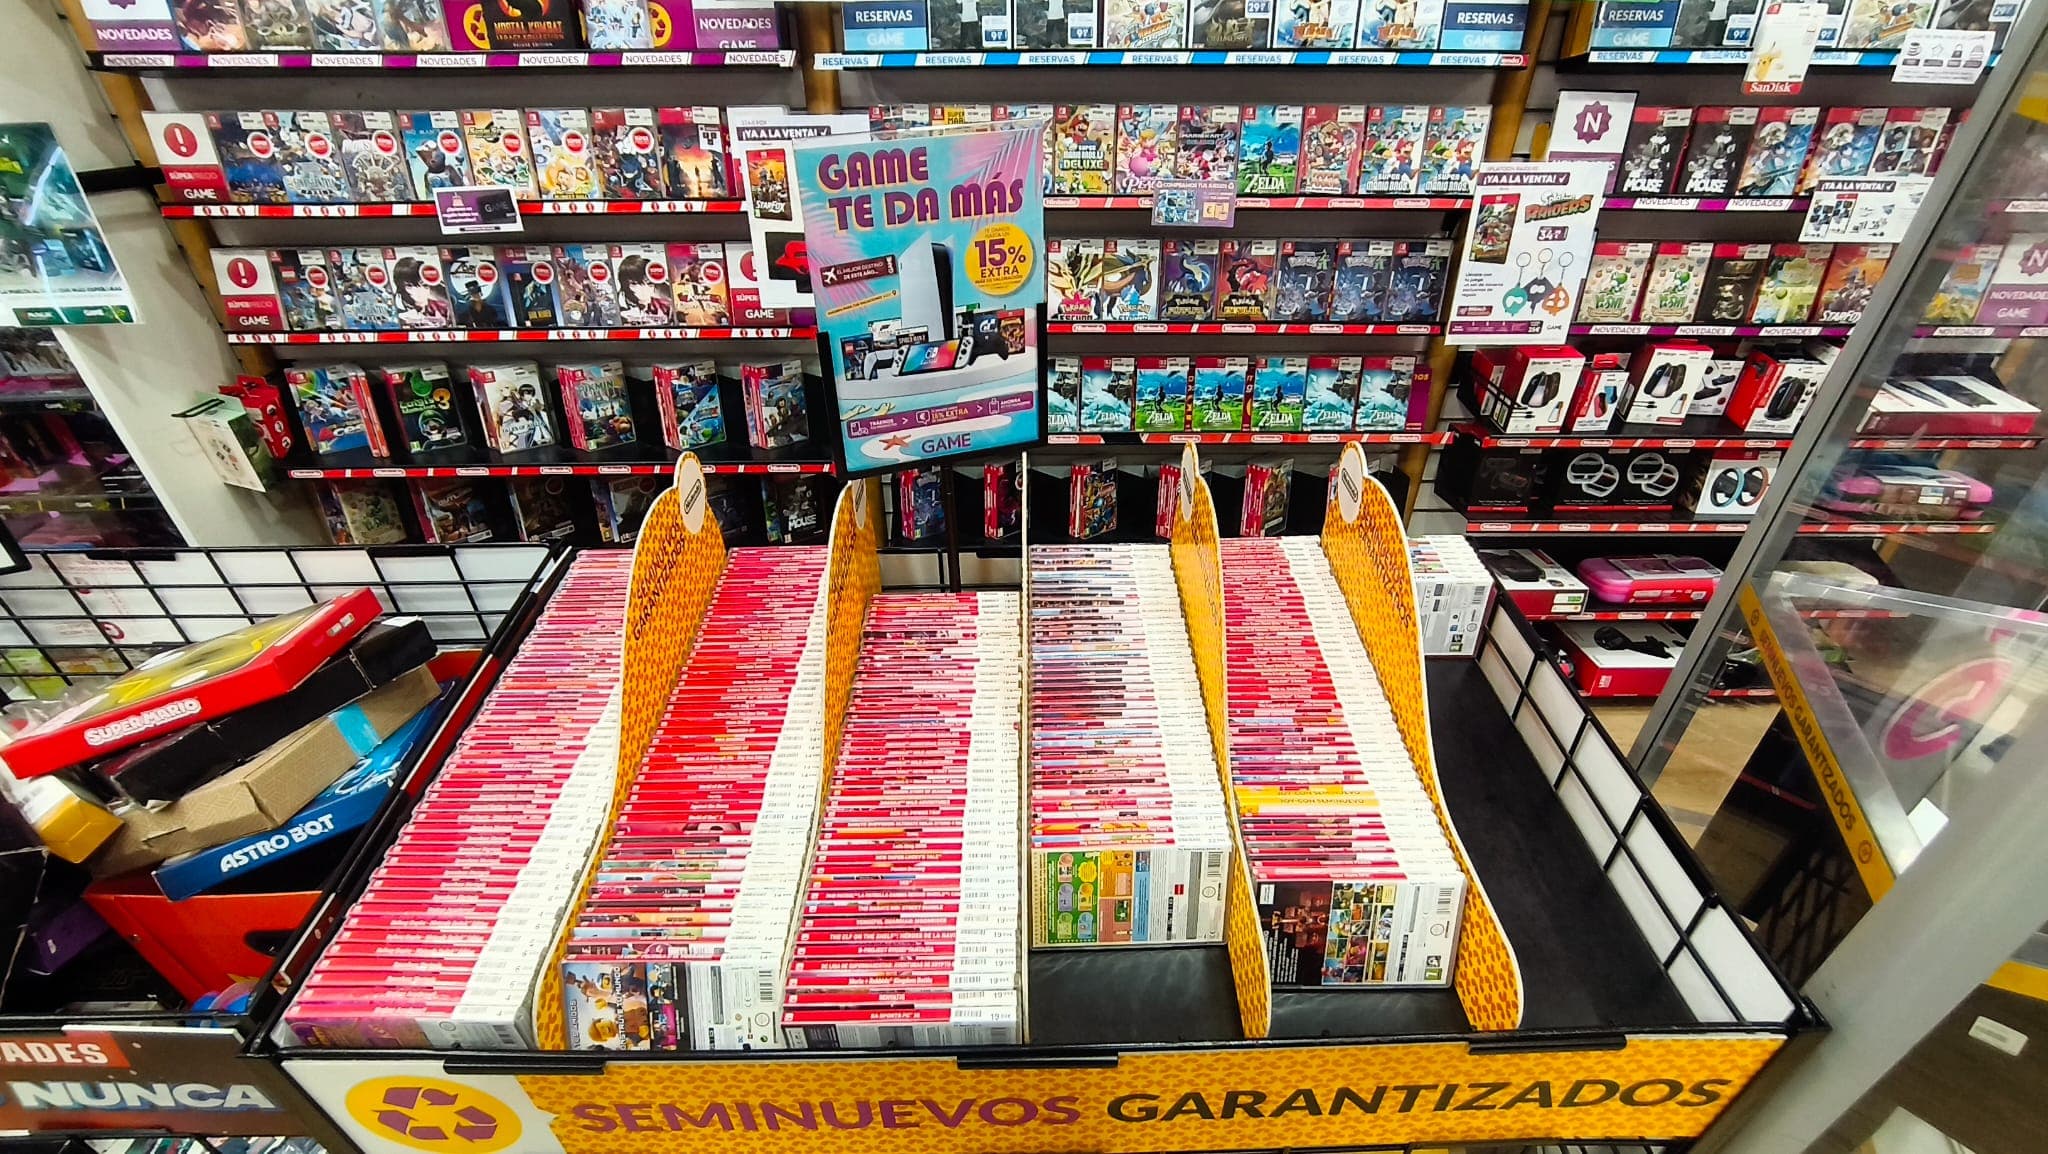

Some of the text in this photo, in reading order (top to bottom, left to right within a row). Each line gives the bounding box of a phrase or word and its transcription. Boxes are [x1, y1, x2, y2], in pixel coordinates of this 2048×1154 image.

[856, 10, 913, 23] RESERVAS
[1456, 12, 1514, 24] RESERVAS
[1608, 9, 1664, 21] RESERVAS
[699, 18, 771, 30] NOVEDADES
[97, 28, 173, 41] NOVEDADES
[866, 31, 904, 46] GAME
[1612, 31, 1650, 46] GAME
[212, 56, 270, 65] NOVEDADES
[315, 56, 374, 65] NOVEDADES
[420, 56, 477, 65] NOVEDADES
[523, 56, 579, 64] NOVEDADES
[626, 55, 682, 63] NOVEDADES
[729, 54, 786, 63] NOVEDADES
[822, 56, 869, 66] RESERVAS
[925, 56, 972, 65] RESERVAS
[1029, 55, 1076, 64] RESERVAS
[1132, 55, 1179, 63] RESERVAS
[1236, 55, 1282, 63] RESERVAS
[1338, 55, 1386, 63] RESERVAS
[1441, 55, 1487, 64] RESERVAS
[1749, 82, 1792, 94] SanDisk
[768, 129, 782, 138] LA
[818, 146, 929, 190] GAME
[1063, 160, 1105, 169] DELUXE
[1509, 175, 1522, 183] LA
[1523, 174, 1556, 183] VENTA!
[1623, 179, 1664, 192] MOUSE
[1686, 179, 1727, 192] MOUSE
[184, 188, 217, 199] GAME
[828, 172, 1023, 231] TE DA MÁS
[1732, 199, 1783, 207] NOVEDADES
[1525, 195, 1594, 223] RAIDERS
[975, 238, 1026, 267] 15%
[981, 266, 1019, 278] EXTRA
[745, 309, 774, 319] GAME
[240, 316, 270, 326] GAME
[922, 433, 971, 454] GAME
[789, 514, 817, 531] MOUSE
[1758, 631, 1798, 707] SEMINUEVOS
[84, 698, 202, 747] SUPER MARIO
[1795, 705, 1857, 831] GARANTIZADOS
[219, 813, 335, 874] ASTRO BOT
[613, 966, 622, 995] MUNDO
[616, 1009, 628, 1051] ONSTRUYE
[7, 1081, 277, 1109] NUNCA
[574, 1078, 1733, 1133] SEMINUEVOS GARANTIZADOS
